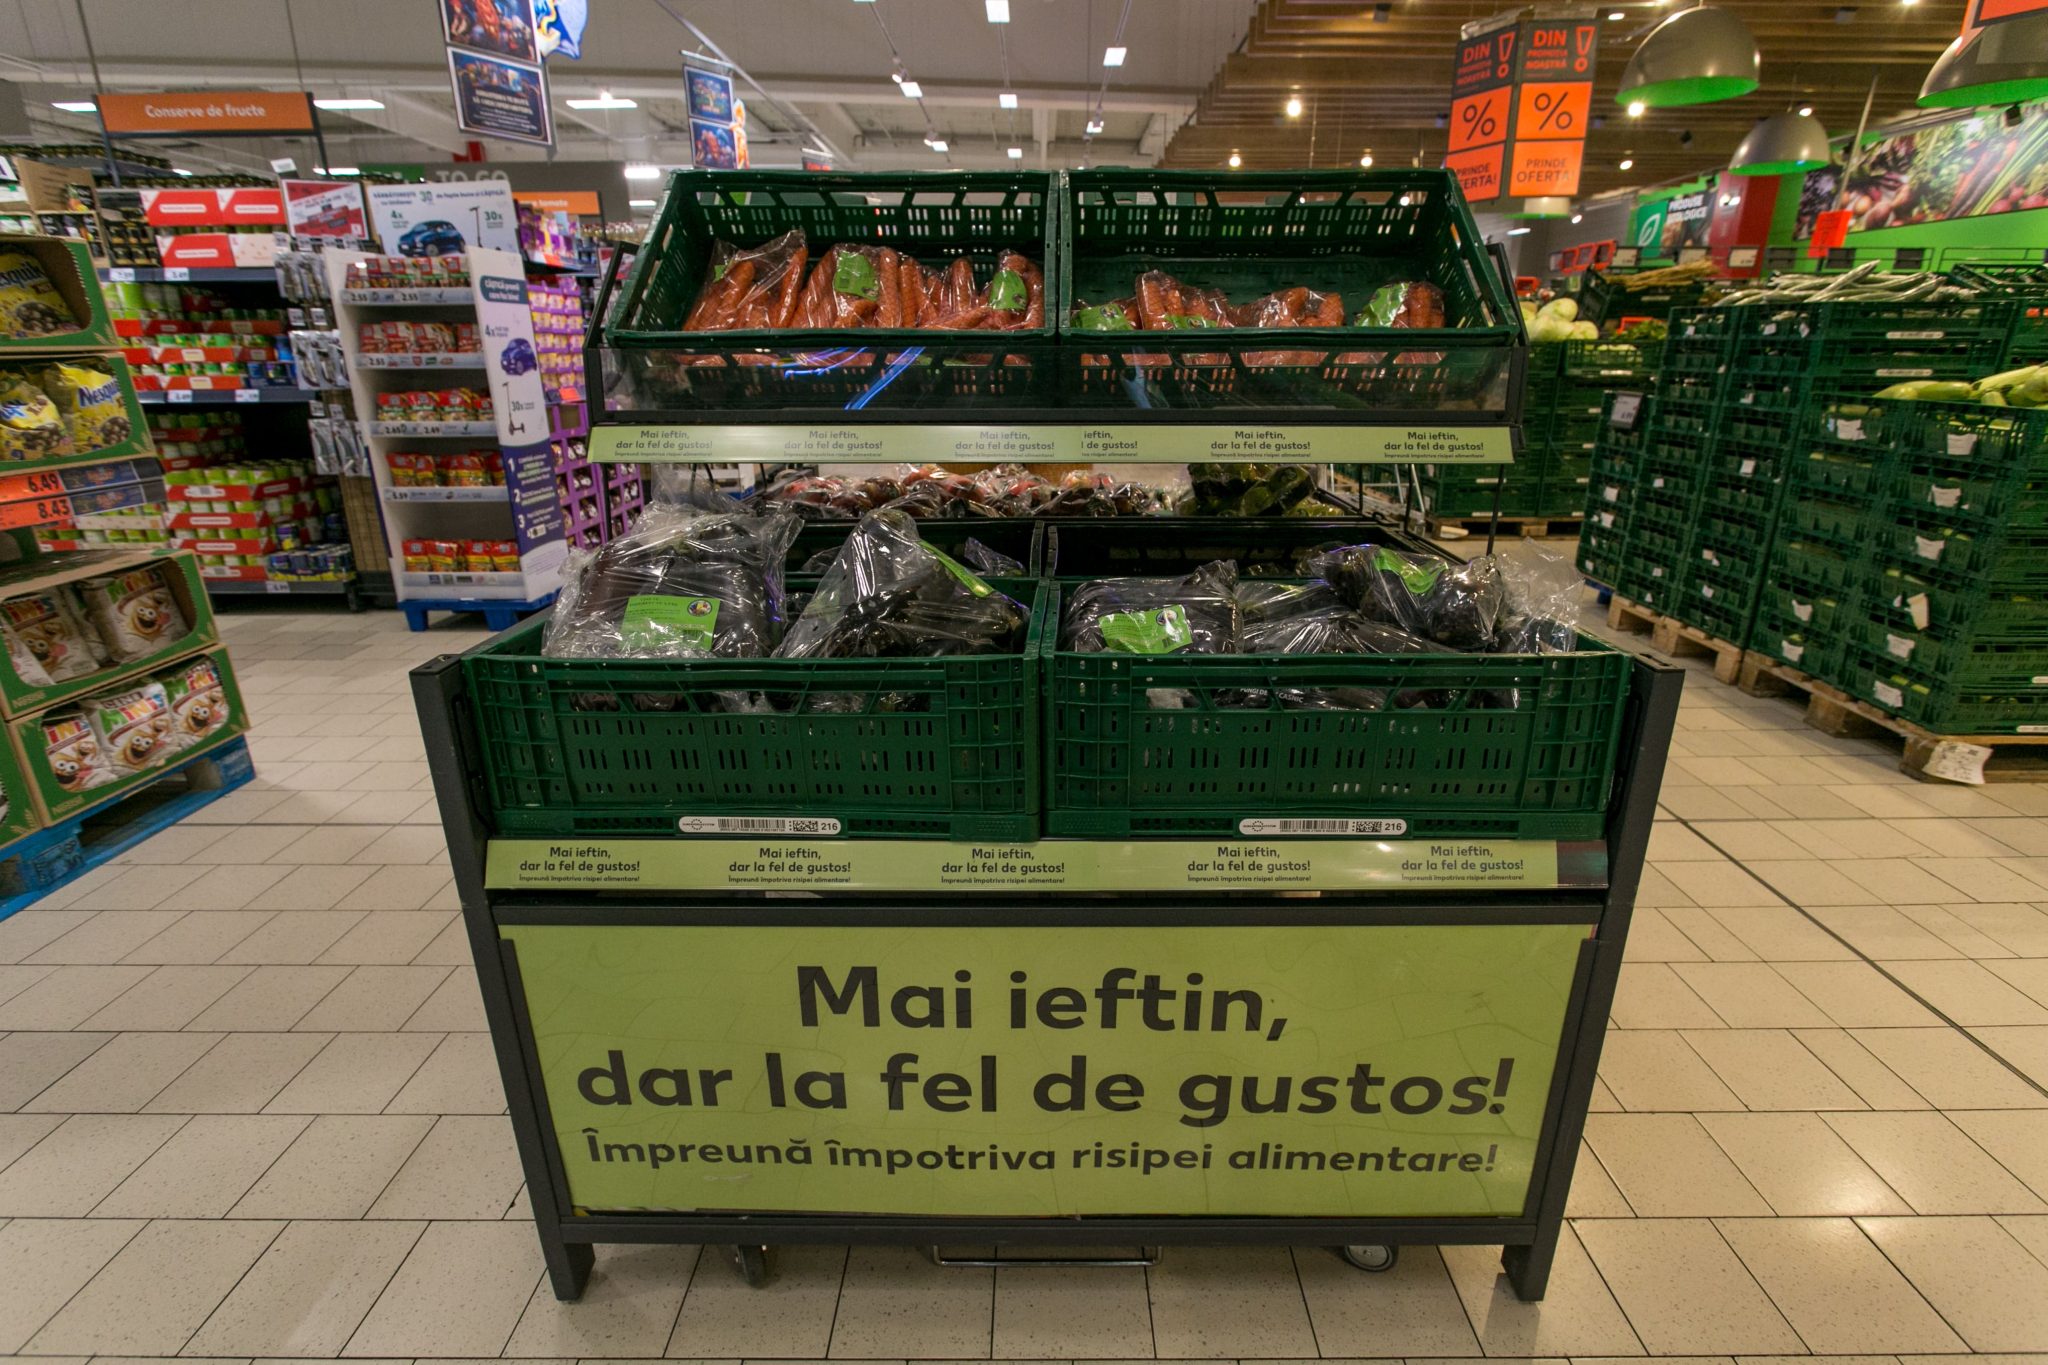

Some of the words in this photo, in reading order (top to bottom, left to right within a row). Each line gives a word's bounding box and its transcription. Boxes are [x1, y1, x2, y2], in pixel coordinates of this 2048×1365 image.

[1533, 30, 1567, 48] DIN
[1463, 43, 1491, 64] DIN
[145, 104, 204, 118] Conserve
[207, 105, 222, 117] de
[225, 105, 266, 117] fructe
[1526, 158, 1567, 168] PRINDE
[1460, 174, 1498, 190] ERTA!
[78, 376, 122, 408] Nesqu
[640, 430, 659, 439] Mai
[809, 431, 827, 439] Mai
[980, 431, 998, 439] Mai
[1084, 430, 1113, 440] ieftin,
[1235, 431, 1253, 439] Mai
[1256, 431, 1286, 440] ieftin,
[1408, 432, 1426, 440] Mai
[1429, 432, 1459, 441] ieftin,
[616, 441, 632, 449] dar
[636, 441, 645, 449] la
[648, 441, 660, 449] fel
[663, 441, 675, 449] de
[678, 441, 713, 451] gustos!
[784, 441, 801, 449] dar
[804, 441, 813, 449] la
[817, 441, 829, 449] fel
[832, 441, 844, 449] de
[847, 441, 883, 451] gustos!
[955, 442, 973, 450] dar
[976, 442, 985, 450] la
[988, 442, 1000, 450] fel
[1003, 442, 1016, 450] de
[1019, 442, 1054, 452] gustos!
[1087, 441, 1099, 449] de
[1102, 441, 1138, 451] gustos!
[1211, 441, 1228, 449] dar
[1231, 441, 1240, 449] la
[1244, 441, 1257, 449] fel
[1259, 441, 1272, 450] de
[1275, 441, 1311, 451] gustos!
[1384, 442, 1402, 450] dar
[1404, 442, 1414, 450] la
[1417, 442, 1430, 450] fel
[1432, 442, 1445, 450] de
[1448, 442, 1484, 452] gustos!
[508, 458, 516, 472] 1
[27, 474, 59, 493] 6.49
[514, 489, 521, 503] 2
[38, 498, 70, 519] 8.43
[518, 514, 526, 528] 3
[820, 822, 838, 831] 216
[1384, 822, 1402, 831] 216
[550, 847, 572, 857] Mai
[576, 847, 611, 859] ieftin,
[759, 848, 781, 858] Mai
[785, 848, 821, 860] ieftin,
[972, 848, 995, 859] Mai
[998, 848, 1034, 860] ieftin,
[1217, 847, 1240, 857] Mai
[1244, 847, 1280, 858] ieftin,
[1431, 846, 1453, 856] Mai
[1457, 845, 1493, 857] ieftin,
[520, 860, 540, 871] dar
[544, 860, 555, 871] la
[559, 860, 575, 871] fel
[578, 860, 593, 871] de
[597, 860, 640, 873] gustos!
[729, 861, 750, 872] dar
[754, 861, 765, 872] la
[769, 861, 784, 872] fel
[788, 862, 803, 872] de
[807, 862, 851, 875] gustos!
[941, 862, 963, 873] dar
[967, 862, 978, 873] la
[981, 862, 998, 873] fel
[1001, 862, 1017, 873] de
[1020, 862, 1065, 875] gustos!
[1187, 860, 1209, 871] dar
[1213, 860, 1224, 871] la
[1228, 860, 1244, 871] fel
[1248, 860, 1263, 871] de
[1267, 860, 1311, 873] gustos!
[1401, 860, 1422, 870] dar
[1426, 860, 1437, 870] la
[1441, 860, 1457, 870] fel
[1461, 860, 1476, 870] de
[1480, 859, 1524, 872] gustos!
[797, 966, 973, 1029] Mai
[1010, 967, 1288, 1042] ieftin,
[577, 1049, 733, 1107] dar
[766, 1052, 848, 1110] la
[879, 1053, 997, 1113] fel
[1033, 1054, 1145, 1113] de
[1178, 1057, 1515, 1128] gustos!
[582, 1128, 813, 1170] Împreună
[823, 1139, 1055, 1175] împotriva
[1072, 1142, 1212, 1176] risipei
[1228, 1142, 1497, 1174] alimentare!
